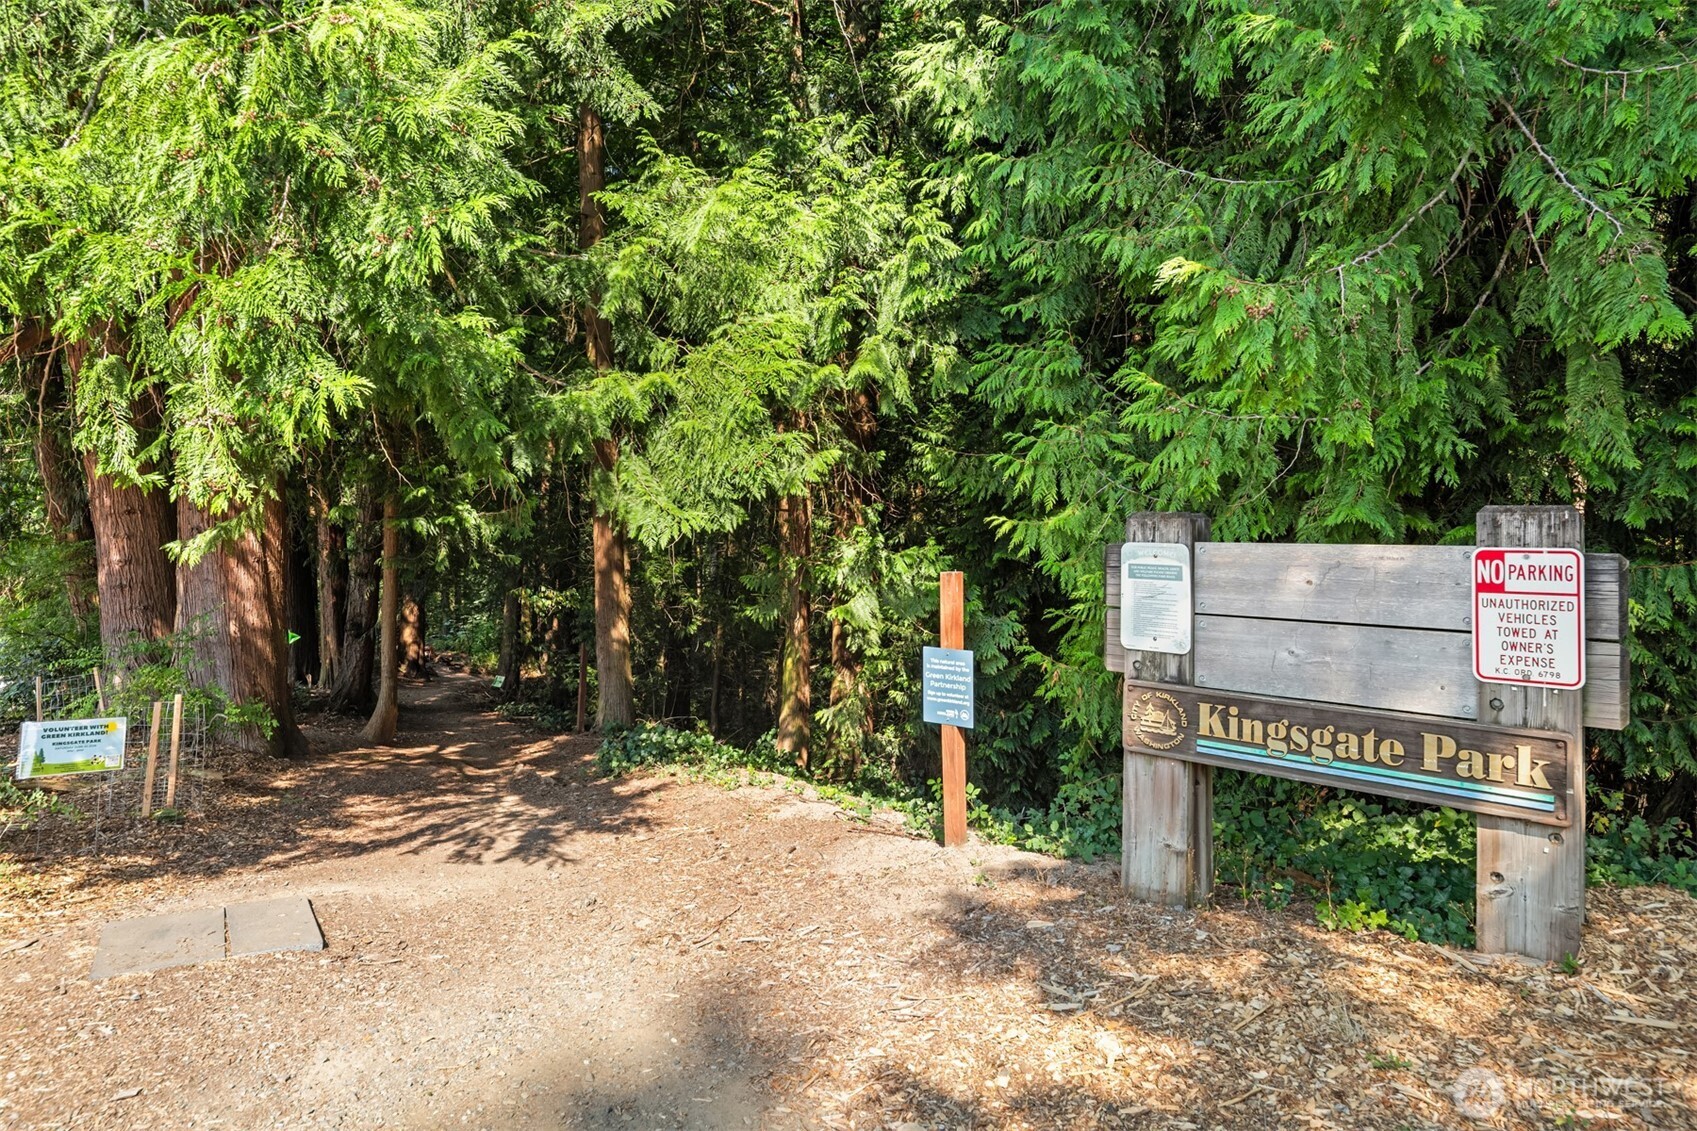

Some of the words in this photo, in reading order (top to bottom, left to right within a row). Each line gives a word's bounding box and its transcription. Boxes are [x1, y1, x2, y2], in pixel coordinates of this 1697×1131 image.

[1477, 559, 1505, 585] NO
[1508, 564, 1574, 582] PARKING
[1481, 598, 1575, 612] UNAUTHORIZED
[1498, 613, 1557, 626] VEHICLES
[1497, 626, 1537, 639] TOWED
[1544, 629, 1559, 640] AT
[1501, 641, 1554, 655] OWNER'S
[1499, 655, 1556, 669] EXPENSE
[925, 671, 944, 680] Green
[945, 673, 971, 683] Kirkland
[1514, 669, 1535, 677] ORD.
[1538, 671, 1561, 679] 6798
[929, 681, 967, 692] Partnership
[1130, 700, 1141, 720] CITY
[1141, 691, 1153, 701] OF
[1155, 691, 1188, 727] KIRKLAND
[43, 725, 88, 733] VOLUNTEER
[1133, 725, 1185, 750] WASHINGTON
[1196, 701, 1406, 767] Kingsgate
[1419, 732, 1553, 790] Park
